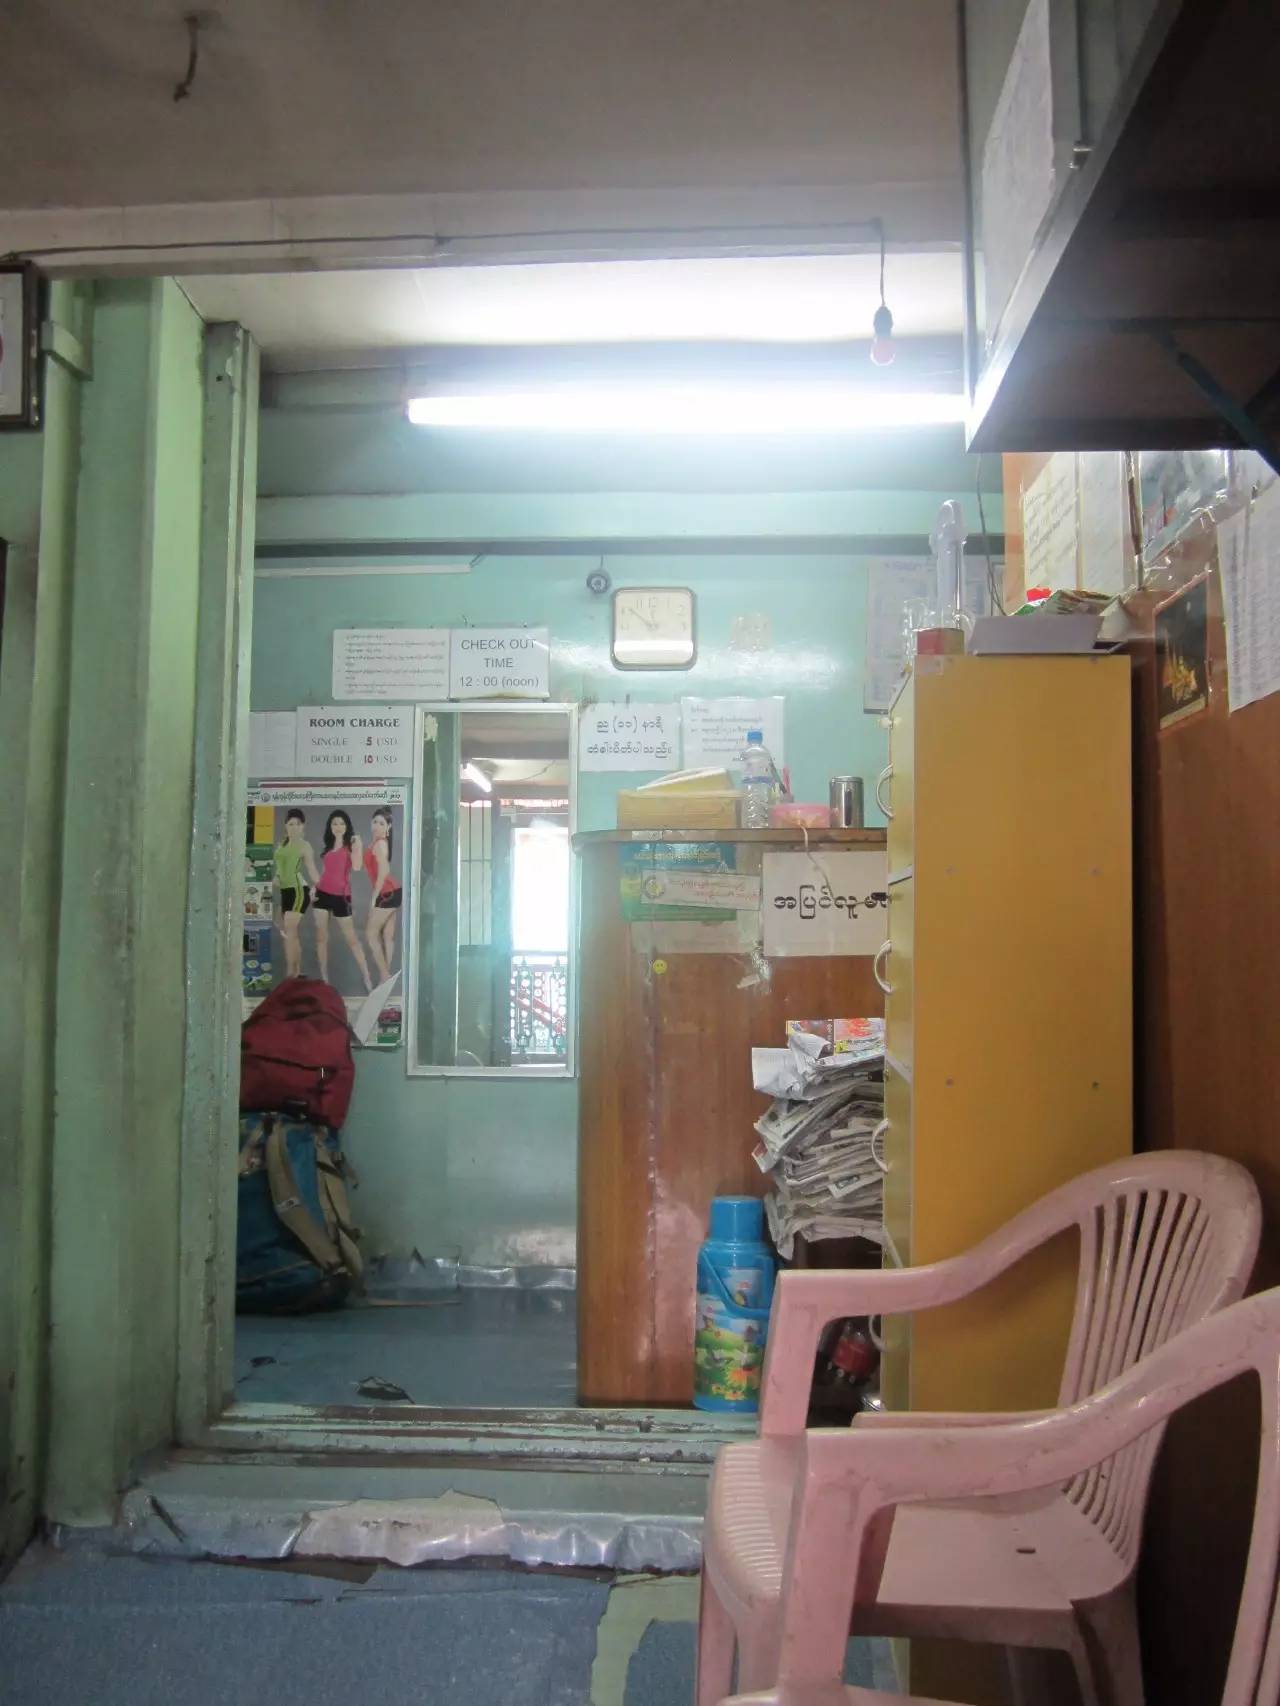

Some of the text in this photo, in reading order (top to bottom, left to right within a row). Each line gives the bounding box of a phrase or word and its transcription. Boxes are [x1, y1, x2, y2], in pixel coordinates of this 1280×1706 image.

[461, 638, 537, 650] CHECK OUT
[484, 657, 513, 668] TIME
[460, 675, 473, 687] 12
[483, 676, 498, 687] 00
[502, 676, 540, 688] (noon)
[309, 718, 400, 728] ROOM CHARGE
[311, 736, 398, 746] SINGLE 5 USD
[310, 754, 398, 764] DOUBLE 10 USD
